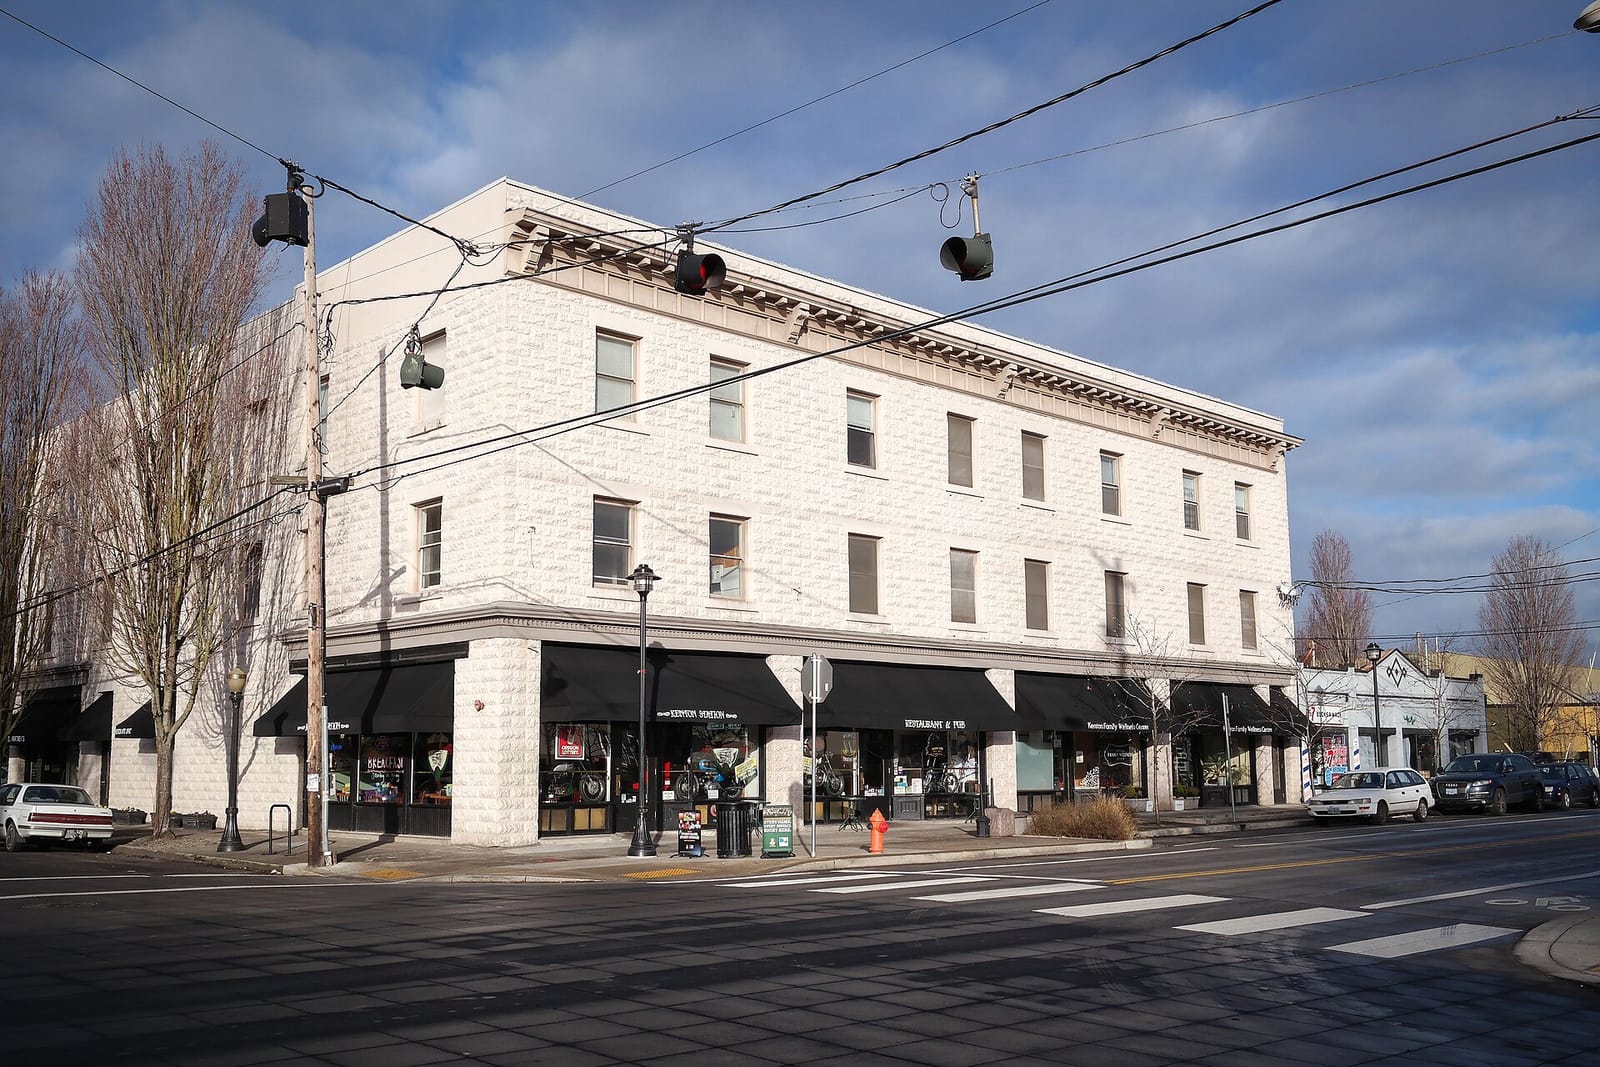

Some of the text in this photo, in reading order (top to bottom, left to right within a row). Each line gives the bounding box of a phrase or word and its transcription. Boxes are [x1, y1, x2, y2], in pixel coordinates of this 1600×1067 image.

[904, 719, 943, 729] RESTAURANT
[952, 720, 966, 729] PUB
[1103, 722, 1118, 732] Family
